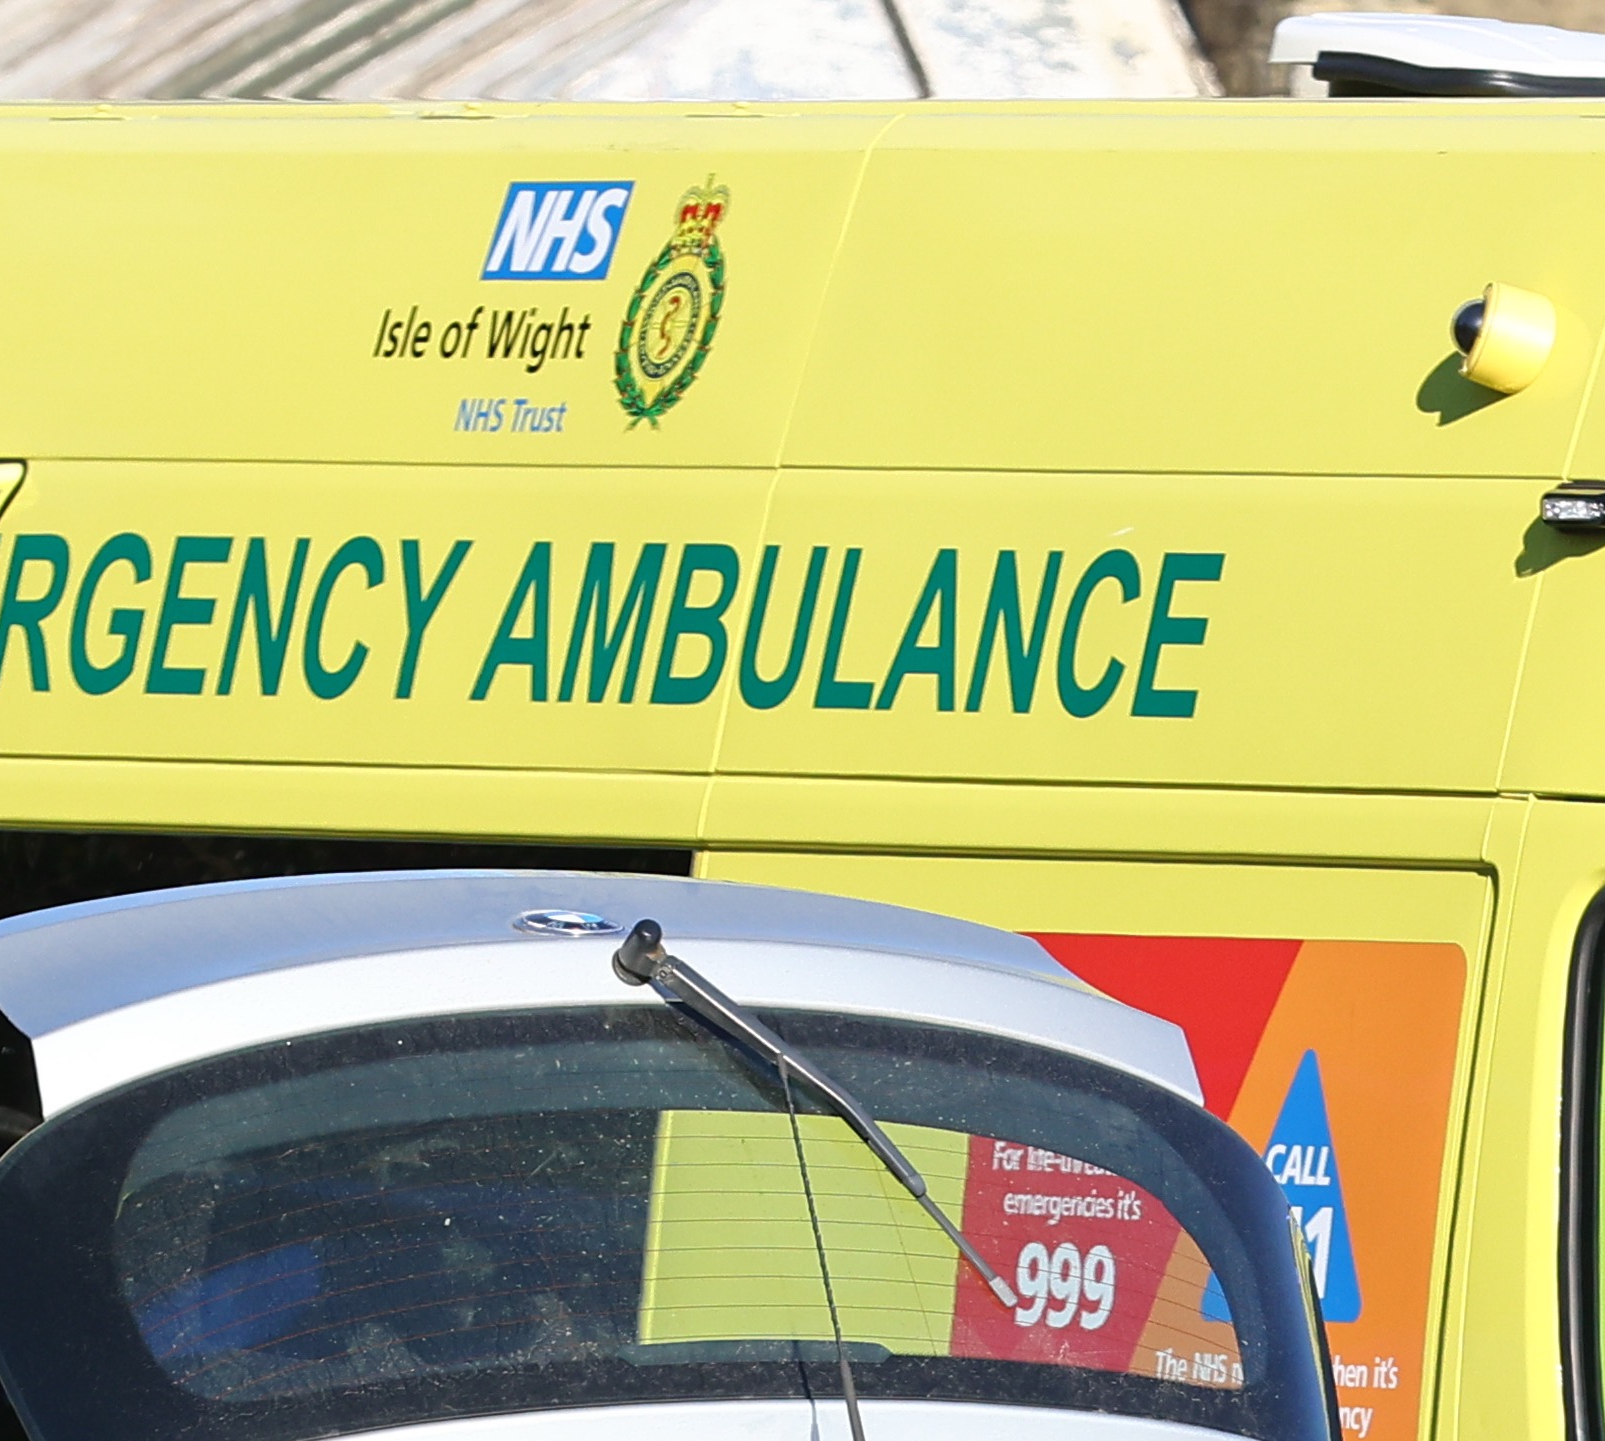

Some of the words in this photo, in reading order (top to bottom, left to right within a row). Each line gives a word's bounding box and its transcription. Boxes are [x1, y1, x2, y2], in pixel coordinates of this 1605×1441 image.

[486, 188, 629, 274] NHS
[373, 305, 432, 358] Isle
[439, 306, 484, 358] of
[486, 306, 591, 373] Wight
[454, 399, 506, 432] NHS
[510, 399, 567, 432] Trust
[469, 540, 1226, 720] AMBULANCE
[992, 1141, 1024, 1170] For
[1265, 1144, 1331, 1186] CALL
[1003, 1188, 1115, 1226] emergencies
[1116, 1190, 1142, 1220] it's
[1014, 1242, 1115, 1330] 999
[1155, 1348, 1187, 1381] The
[1192, 1352, 1228, 1384] NHS
[1331, 1355, 1368, 1388] hen
[1372, 1356, 1398, 1389] it's
